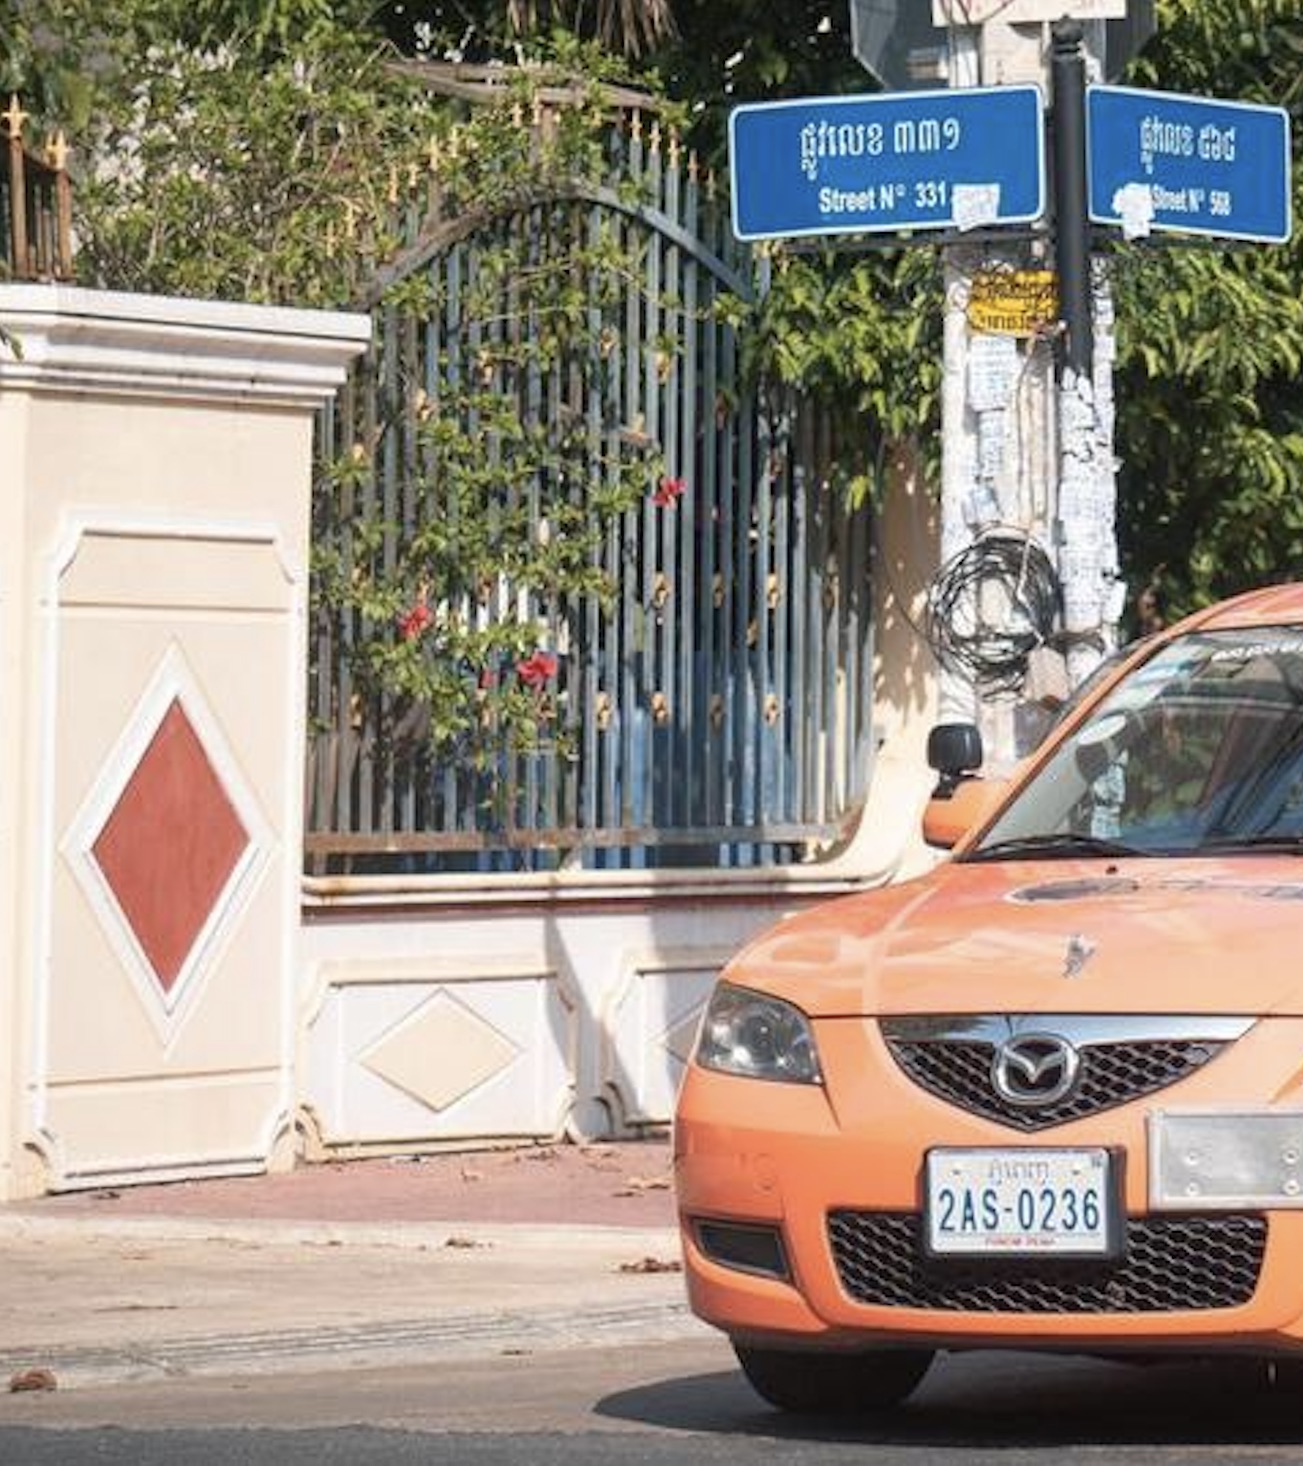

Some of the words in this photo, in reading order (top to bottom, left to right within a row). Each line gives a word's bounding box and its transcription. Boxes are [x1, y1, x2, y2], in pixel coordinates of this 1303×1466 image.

[801, 120, 883, 180] ផ្លូវលេខ
[894, 118, 960, 153] ៣៣១
[819, 186, 876, 214] Street
[915, 181, 946, 207] 331
[1152, 184, 1188, 212] Street
[939, 1188, 1099, 1231] 2AS-0236
